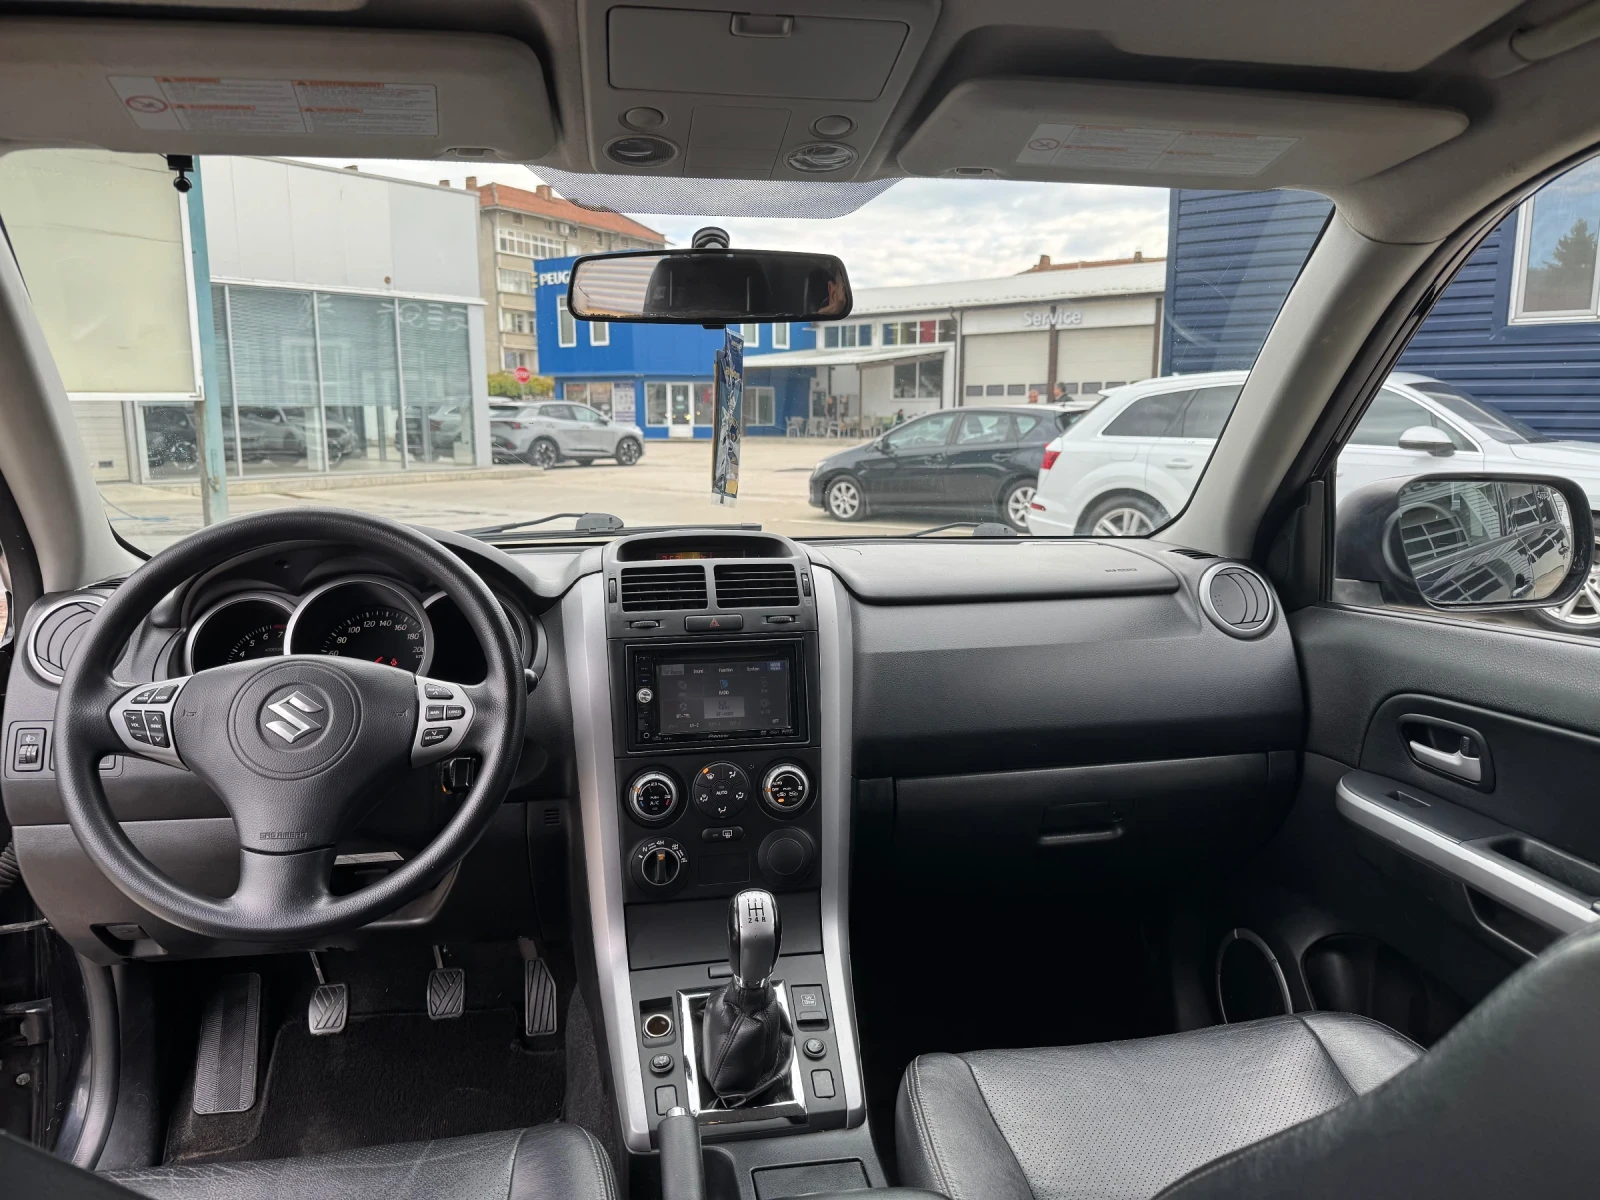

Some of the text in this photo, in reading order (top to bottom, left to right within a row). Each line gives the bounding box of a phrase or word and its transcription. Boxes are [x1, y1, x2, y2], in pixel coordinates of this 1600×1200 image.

[1022, 310, 1082, 327] Service
[363, 620, 376, 628] 120
[379, 619, 392, 627] 140
[394, 623, 408, 631] 160
[347, 625, 361, 634] 100
[262, 632, 269, 641] 6
[277, 631, 284, 639] 7
[407, 632, 420, 641] 180
[249, 639, 256, 647] 5
[336, 636, 348, 644] 80
[239, 650, 246, 658] 4
